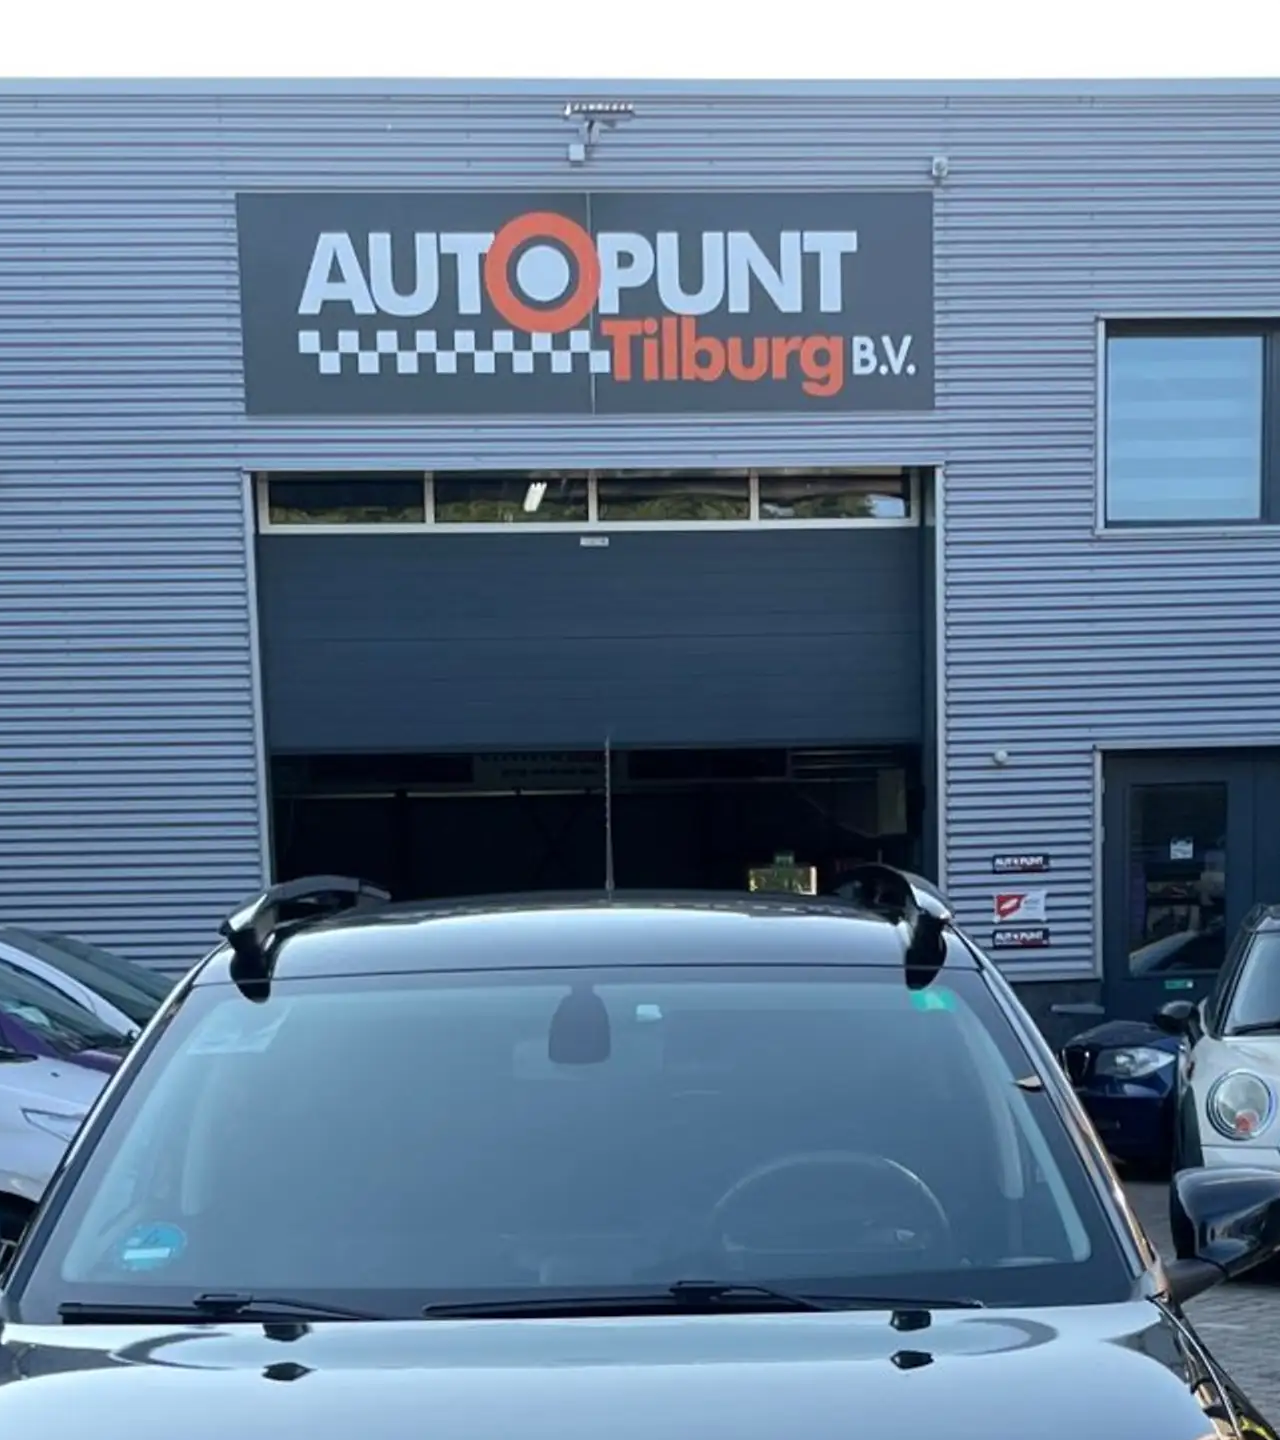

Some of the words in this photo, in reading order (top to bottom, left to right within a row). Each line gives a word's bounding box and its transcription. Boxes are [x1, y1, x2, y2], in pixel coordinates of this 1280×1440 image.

[297, 211, 858, 334] AUTOPUNT
[600, 314, 844, 396] Tilburg
[852, 334, 916, 375] B.V.
